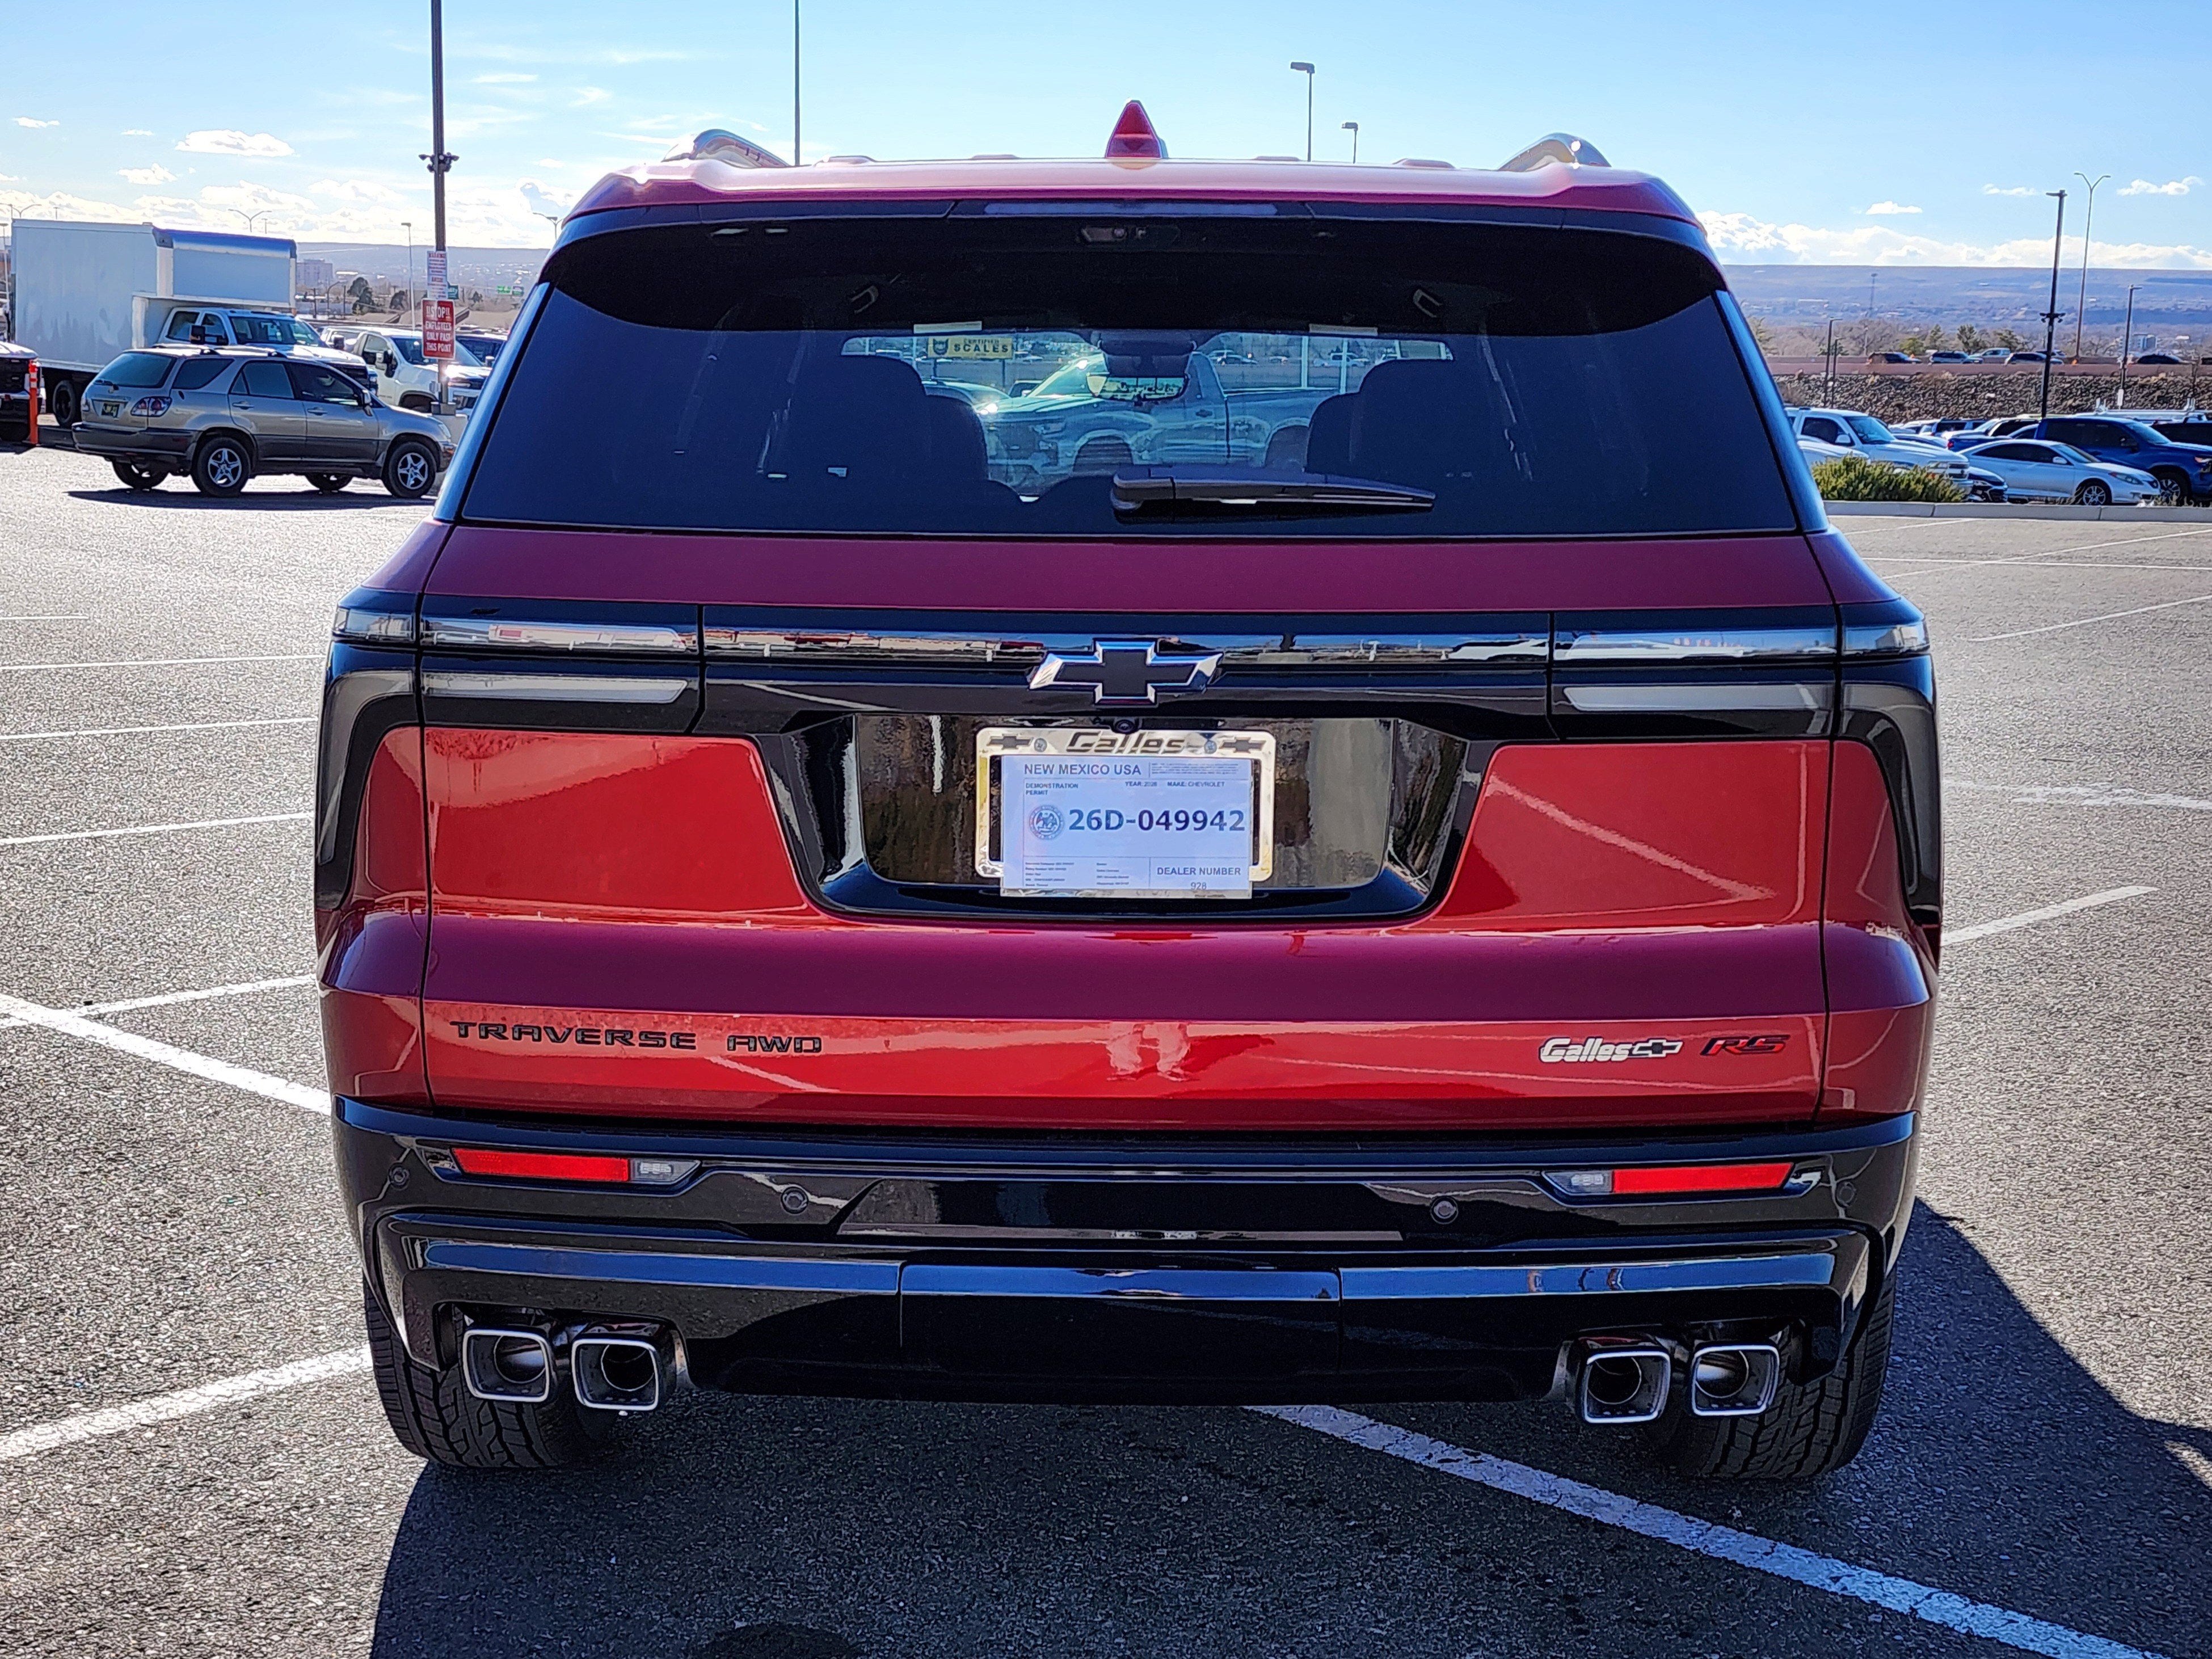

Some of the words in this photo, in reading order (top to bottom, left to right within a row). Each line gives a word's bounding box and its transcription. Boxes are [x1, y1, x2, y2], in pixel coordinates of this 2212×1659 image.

[427, 331, 439, 340] ONLY
[440, 332, 451, 342] PAST
[426, 342, 437, 351] THIS
[437, 343, 451, 352] POINT
[954, 344, 1009, 352] SCALES
[1066, 731, 1185, 753] Galles
[1024, 764, 1055, 774] NEW
[1059, 764, 1110, 775] MEXICO
[1114, 764, 1141, 776] USA
[1069, 809, 1245, 831] 26D-049942
[1157, 867, 1196, 875] DEALER
[1199, 867, 1241, 875] NUMBER
[449, 1021, 697, 1050] TRAVERSE
[726, 1034, 822, 1054] AWD
[1540, 1036, 1634, 1063] Galles
[1700, 1034, 1790, 1056] RS
